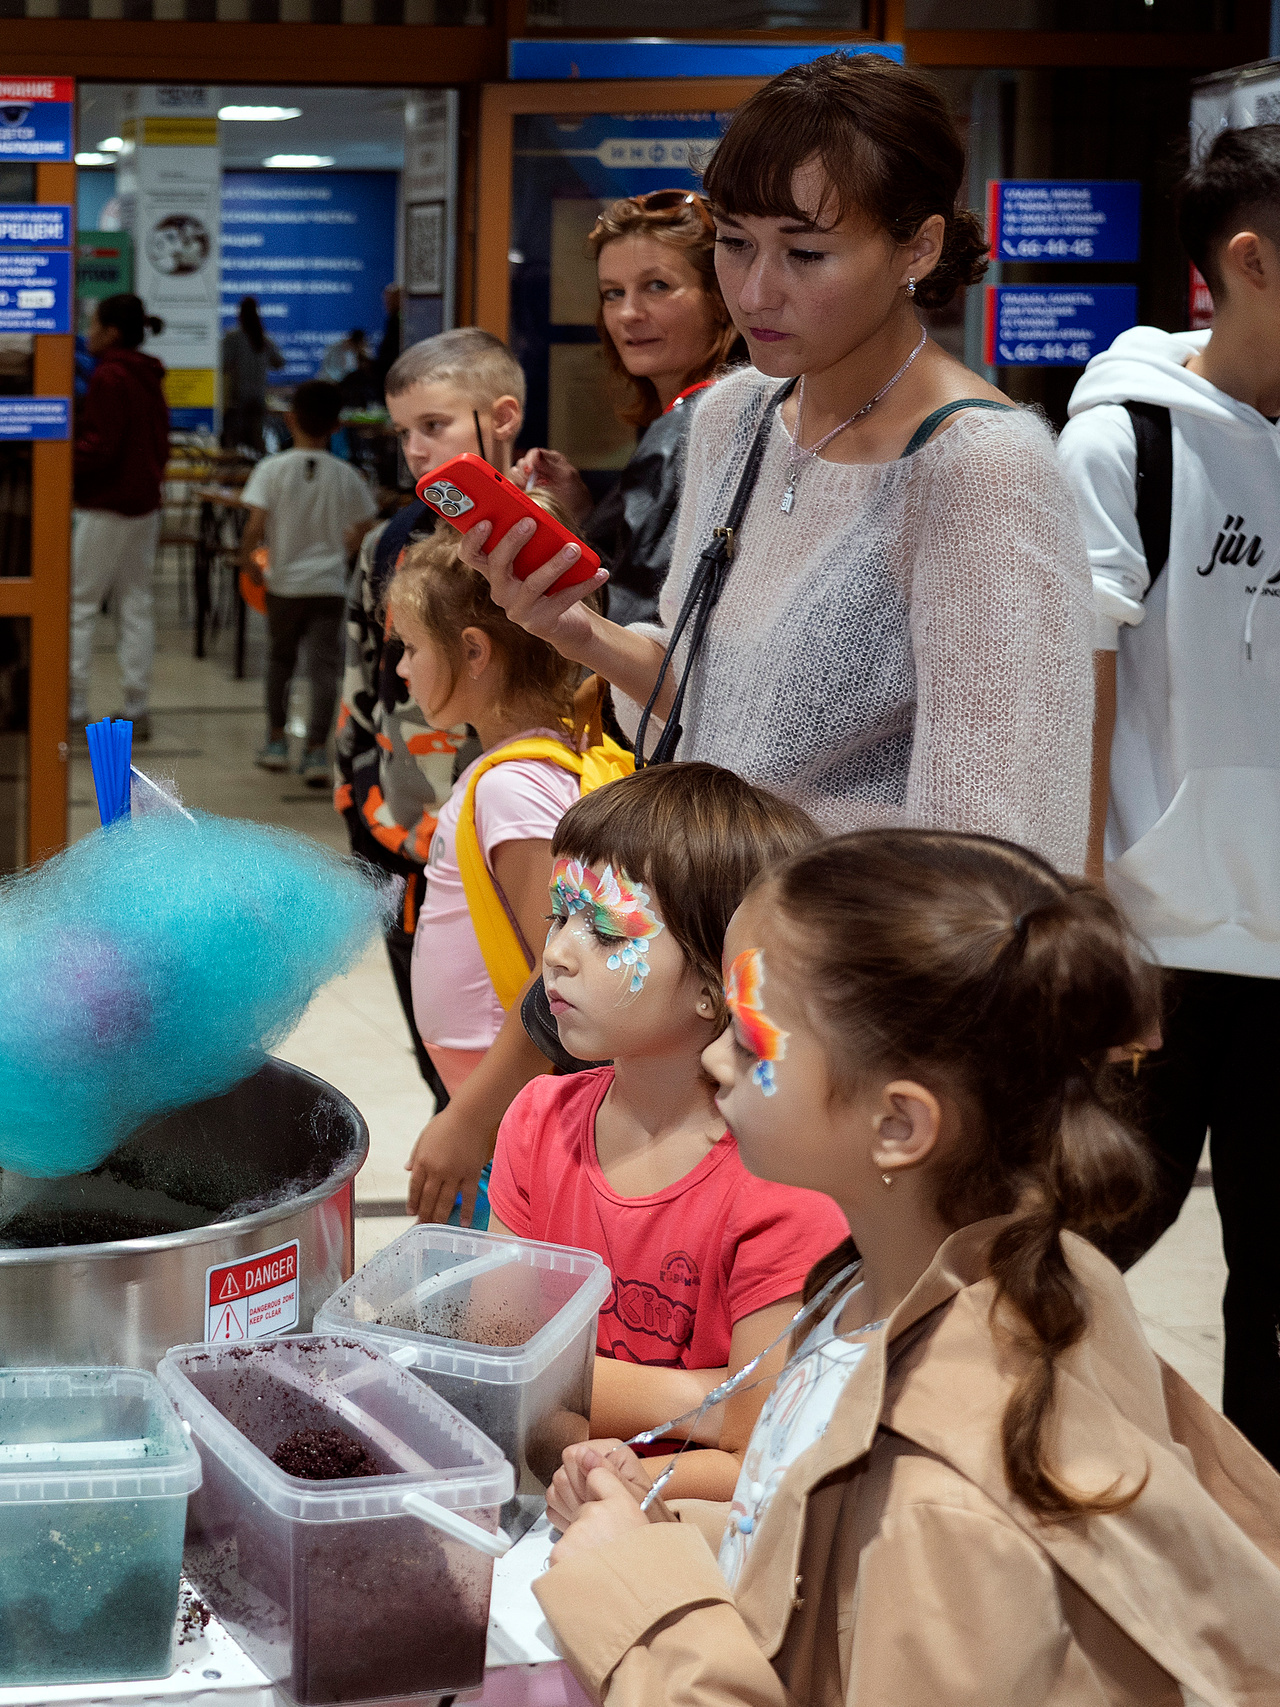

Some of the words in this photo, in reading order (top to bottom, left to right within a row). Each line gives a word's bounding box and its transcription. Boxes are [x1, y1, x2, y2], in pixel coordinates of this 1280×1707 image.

[245, 1255, 294, 1290] DANGER
[249, 1298, 281, 1316] DANGEROUS
[282, 1292, 295, 1304] ZONE
[249, 1313, 264, 1325] KEEP
[265, 1307, 282, 1320] CLEAR
